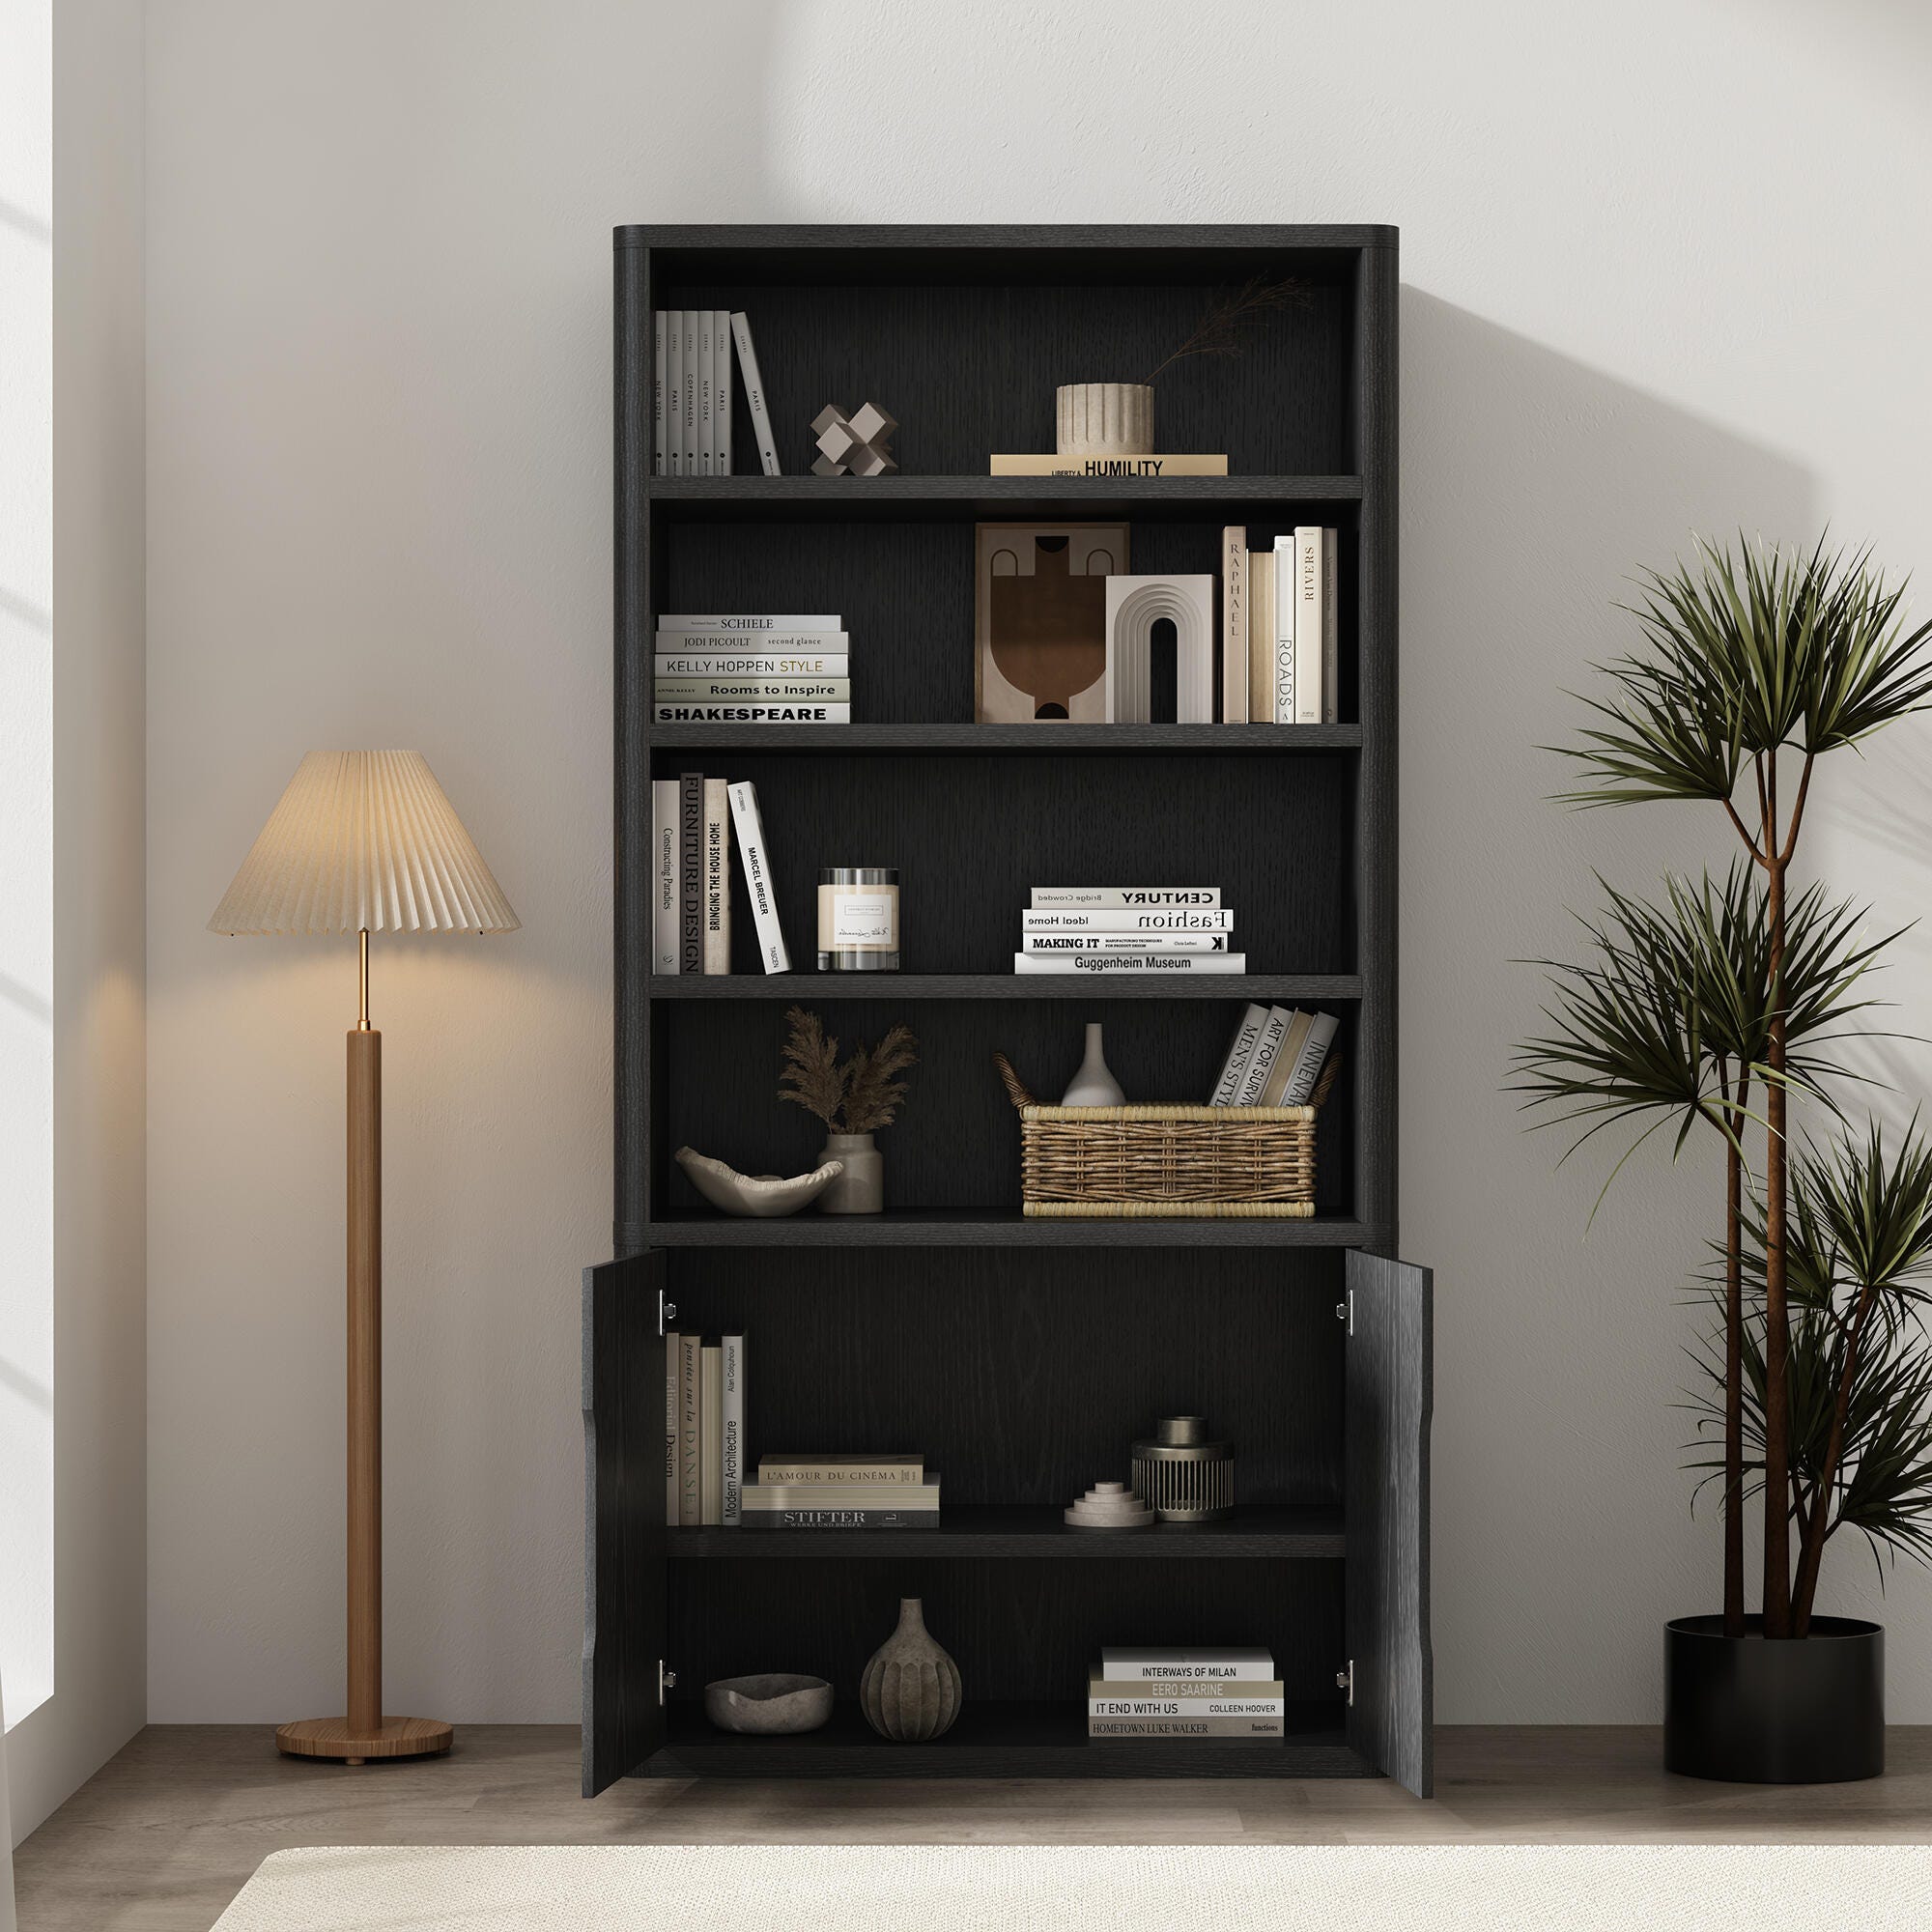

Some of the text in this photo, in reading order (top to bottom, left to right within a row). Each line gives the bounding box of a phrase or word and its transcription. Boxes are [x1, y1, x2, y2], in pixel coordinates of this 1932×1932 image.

[752, 390, 761, 412] PARIS
[1085, 461, 1163, 476] HUMILITY
[1305, 547, 1315, 601] RIVERS
[1231, 544, 1240, 637] RAPHAEL
[721, 619, 774, 629] SCHIELE
[684, 638, 752, 648] JODI PICOULT
[796, 638, 821, 646] glance
[667, 661, 823, 672] KELLY HOPPEN STYLE
[1279, 639, 1293, 707] ROADS
[710, 685, 836, 696] Rooms to Inspire
[659, 708, 827, 721] SHAKESPEARE
[662, 828, 673, 910] Constructing Paradies
[685, 776, 698, 973] FURNITURE DESIGN
[709, 823, 721, 930] BRINGING THE HOUSE HOME
[748, 847, 769, 915] MARCEL BREUER
[1033, 938, 1099, 949] MAKING IT
[1074, 956, 1191, 971] Guggenheim Museum
[1267, 1018, 1284, 1041] ART
[1232, 1024, 1259, 1070] MEN'S
[1256, 1043, 1274, 1067] FOR
[686, 1410, 696, 1422] la
[667, 1435, 675, 1478] Design
[725, 1421, 737, 1479] Architecture
[685, 1430, 696, 1504] DANSE
[767, 1471, 821, 1481] L'AMOUR
[828, 1471, 845, 1481] DU
[725, 1481, 737, 1519] Modern
[784, 1512, 866, 1523] STIFTER
[1142, 1667, 1236, 1677] INTERWAYS OF MILAN
[1152, 1683, 1224, 1696] EERO SAARINE
[1096, 1703, 1179, 1714] IT END WITH US
[1093, 1723, 1208, 1734] HOMETOWN LUKE WALKER
[1251, 1723, 1278, 1732] functions
